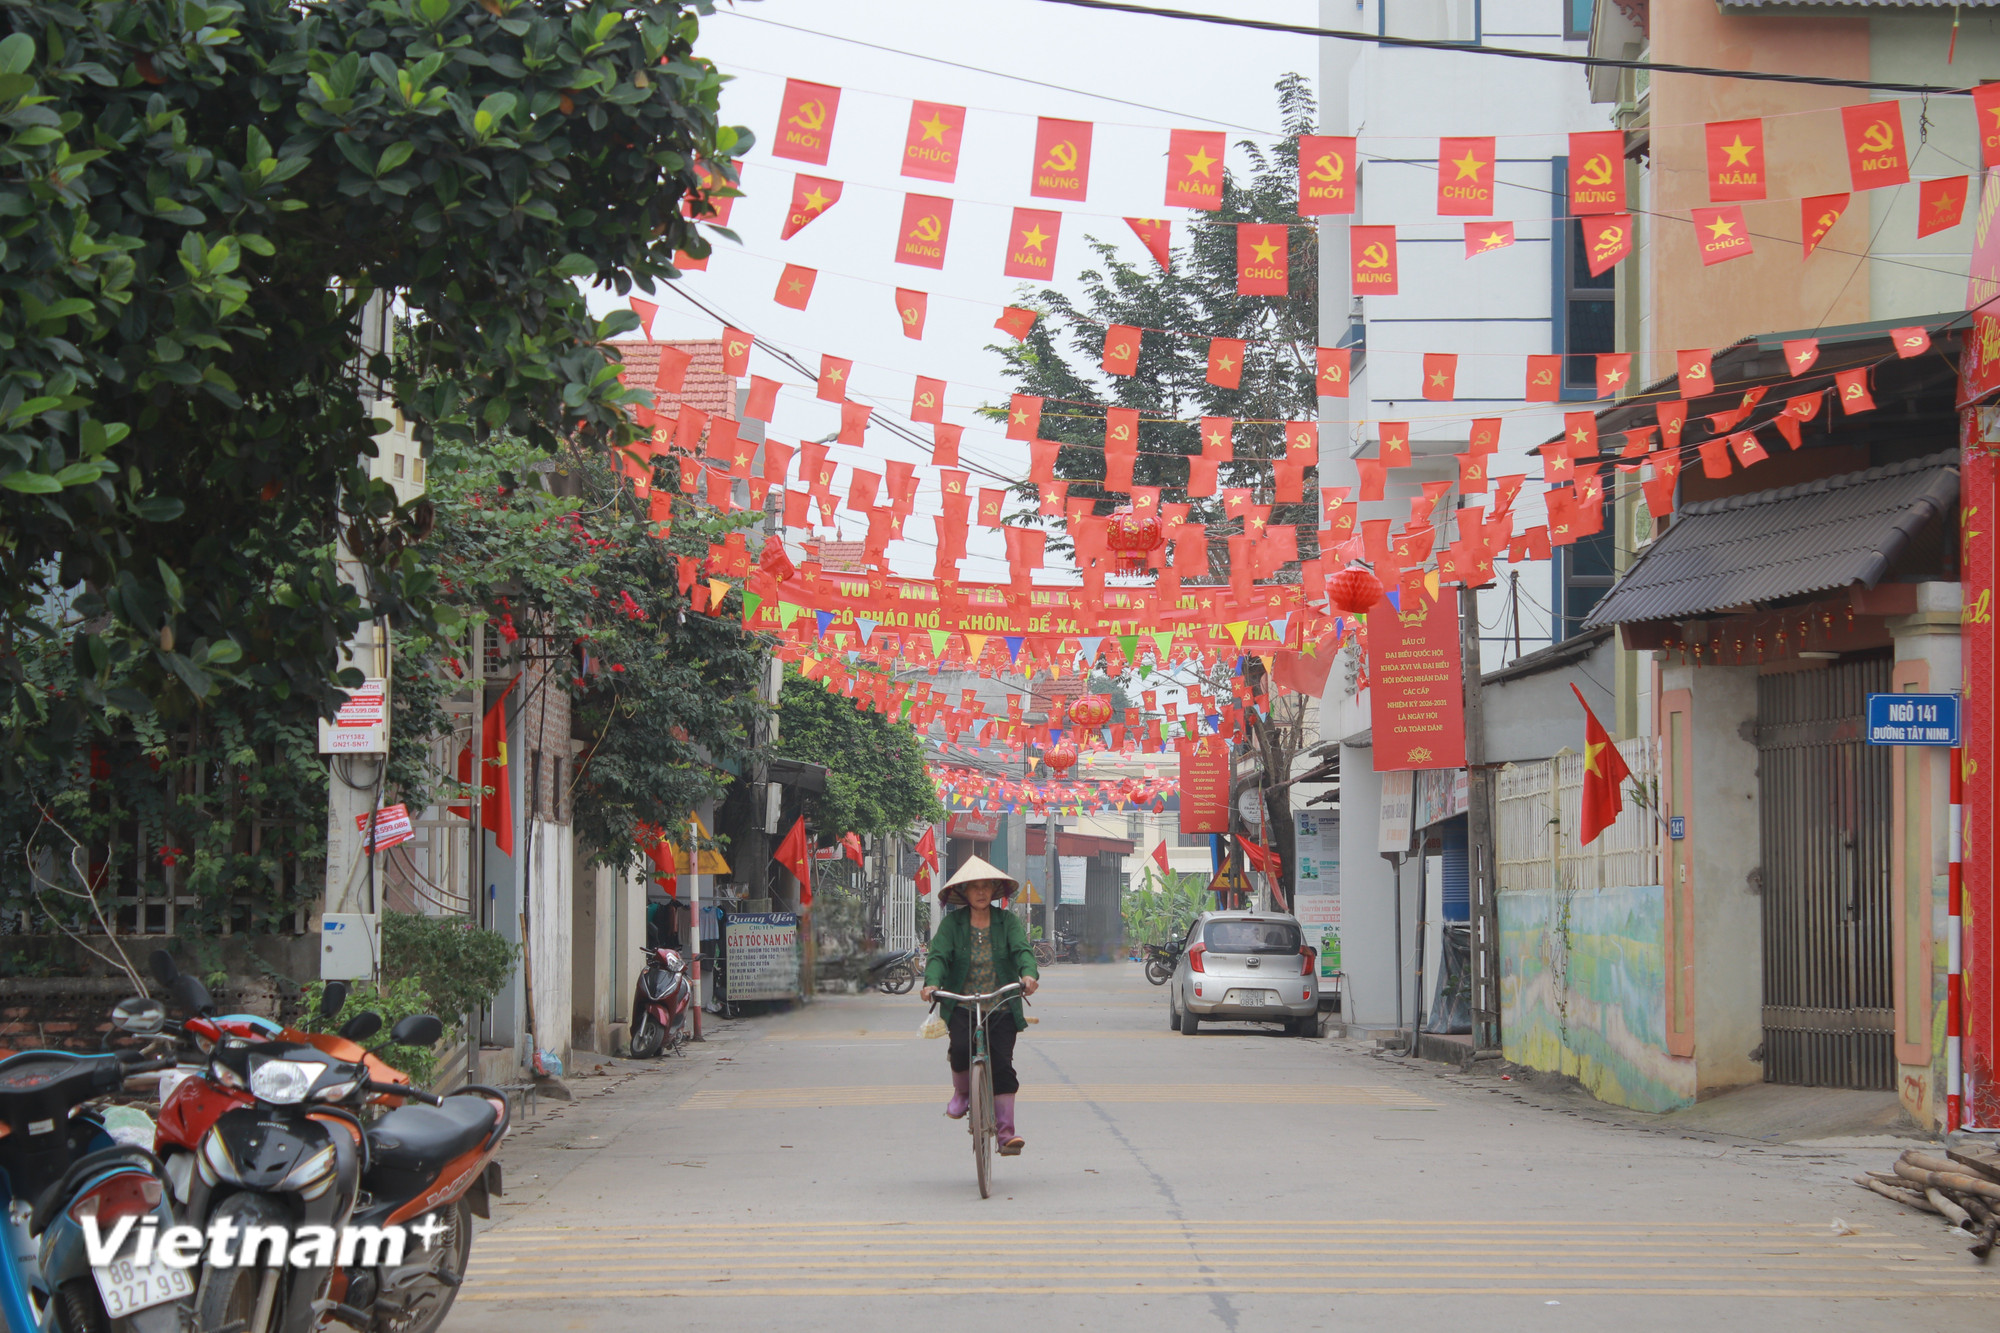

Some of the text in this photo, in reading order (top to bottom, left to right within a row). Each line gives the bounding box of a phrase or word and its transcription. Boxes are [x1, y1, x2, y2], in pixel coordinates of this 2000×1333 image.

[786, 131, 821, 149] MỚI
[908, 145, 952, 163] CHÚC
[1862, 156, 1898, 172] MỚI
[1039, 174, 1080, 190] MỪNG
[1719, 172, 1757, 184] NĂM
[1178, 179, 1216, 196] NĂM
[1308, 185, 1344, 199] MỚI
[1443, 184, 1488, 200] CHÚC
[1575, 189, 1616, 203] MỪNG
[905, 242, 940, 258] MỪNG
[1705, 237, 1745, 252] CHÚC
[1014, 252, 1047, 268] NĂM
[1244, 265, 1284, 280] CHÚC
[1357, 271, 1392, 283] MỪNG
[840, 582, 869, 598] VUI
[914, 608, 941, 628] NỔ
[1028, 612, 1052, 632] ĐỂ
[1889, 700, 1937, 722] NGÕ 141
[1873, 724, 1949, 740] ĐƯỜNG TÂY NINH
[1672, 820, 1683, 834] 141
[728, 914, 765, 924] Quang
[746, 932, 761, 946] TÓC
[763, 934, 781, 946] NAM
[257, 1121, 289, 1130] HONDA
[109, 1271, 186, 1312] 327.99
